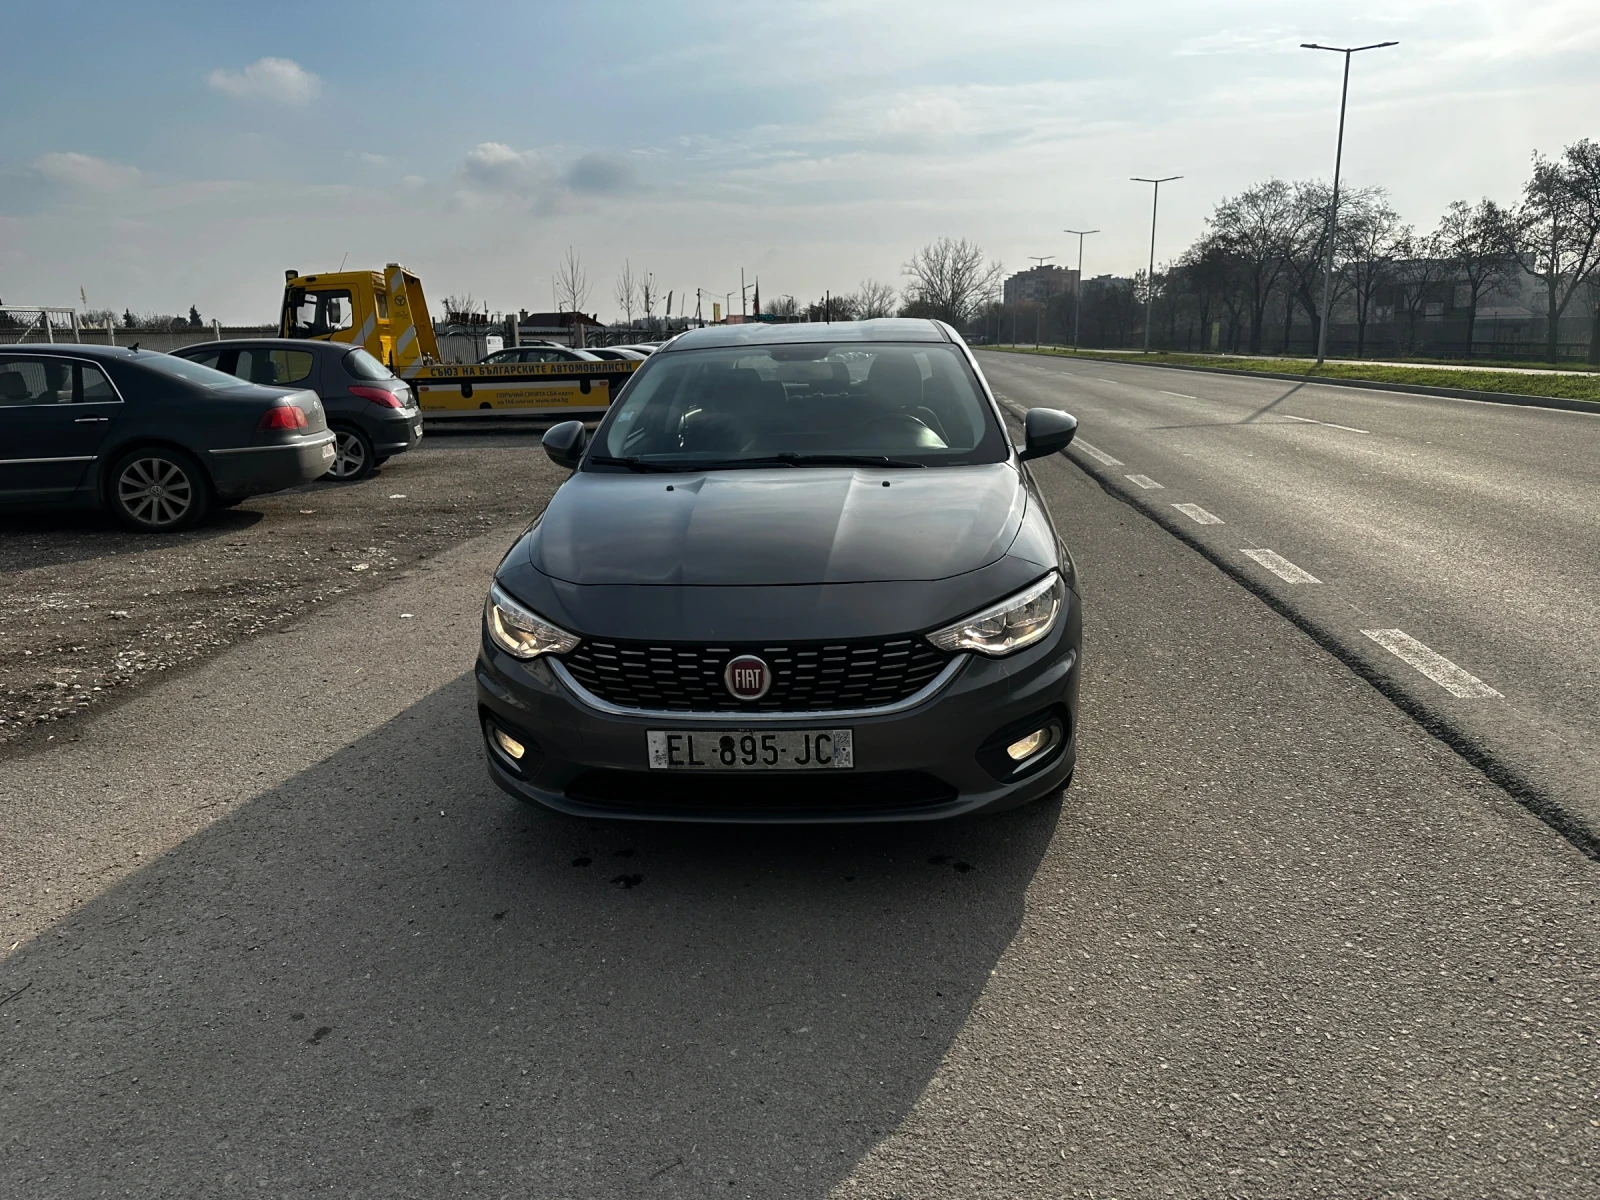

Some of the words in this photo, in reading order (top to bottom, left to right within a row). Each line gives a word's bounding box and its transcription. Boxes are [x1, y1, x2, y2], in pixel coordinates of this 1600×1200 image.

[430, 367, 459, 377] СЪЮЗ
[462, 367, 476, 376] НА
[479, 364, 547, 376] БЪЛГАРСКИТЕ
[550, 362, 632, 374] АВТОМОБИЛИСТИ
[735, 669, 761, 689] FIAT
